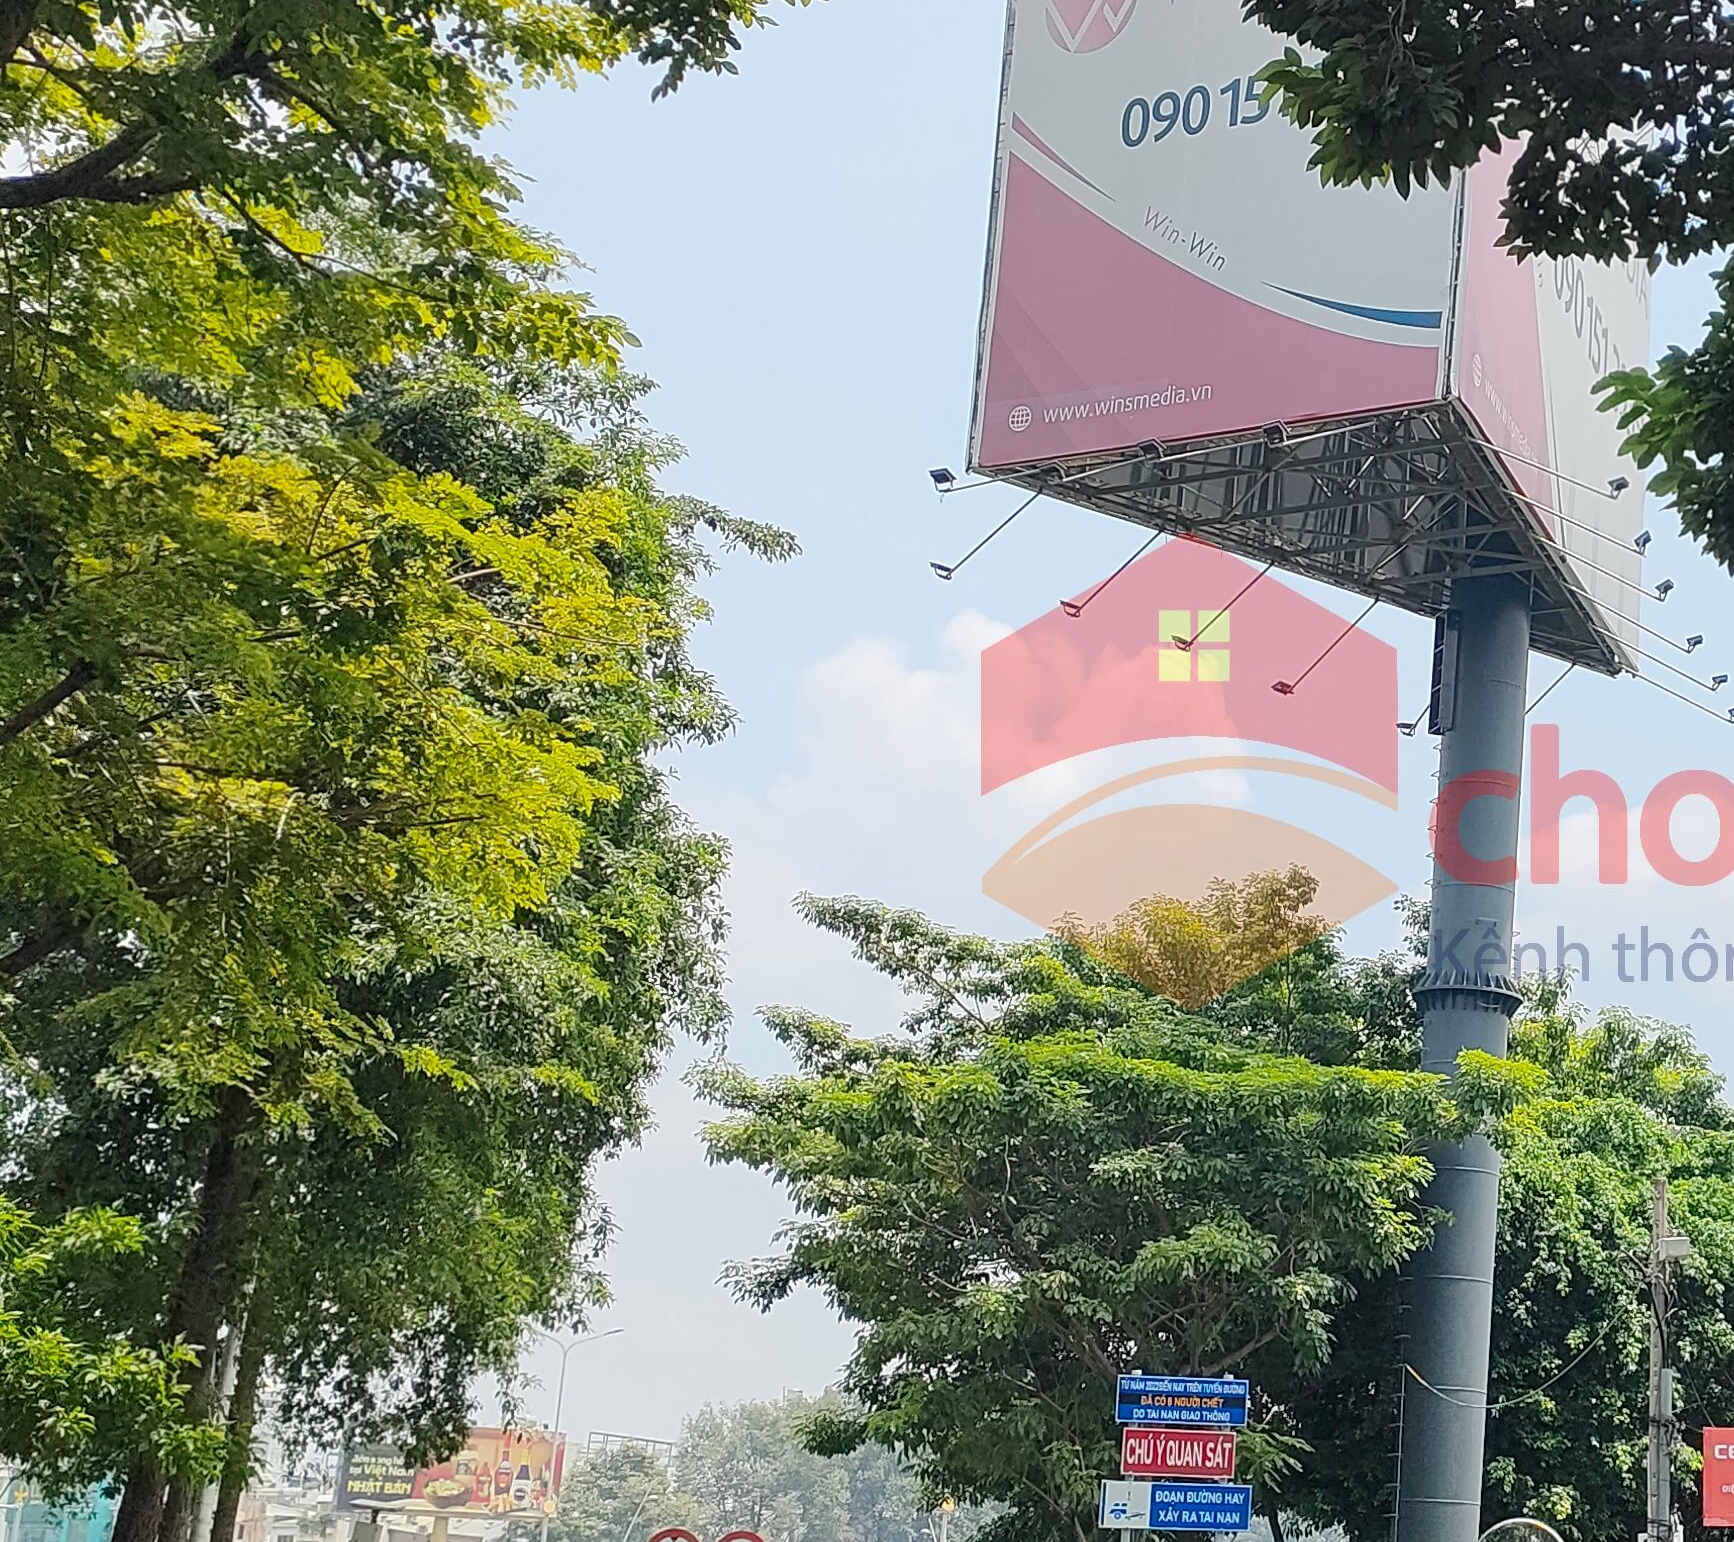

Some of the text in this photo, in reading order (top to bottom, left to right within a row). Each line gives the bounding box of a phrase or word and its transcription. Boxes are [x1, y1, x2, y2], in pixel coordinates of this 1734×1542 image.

[1121, 84, 1211, 149] 090
[1144, 205, 1227, 272] Win-Win
[1042, 384, 1212, 424] www.winsmedia.vn
[1133, 1408, 1145, 1419] DO
[1146, 1409, 1159, 1419] TAI
[1180, 1410, 1200, 1420] GIAO
[1126, 1433, 1232, 1469] CHÚ Ý QUAN SÁT
[1155, 1489, 1245, 1505] ĐOẠN ĐƯỜNG HAY
[1182, 1510, 1197, 1523] RA
[1199, 1511, 1214, 1523] TAI
